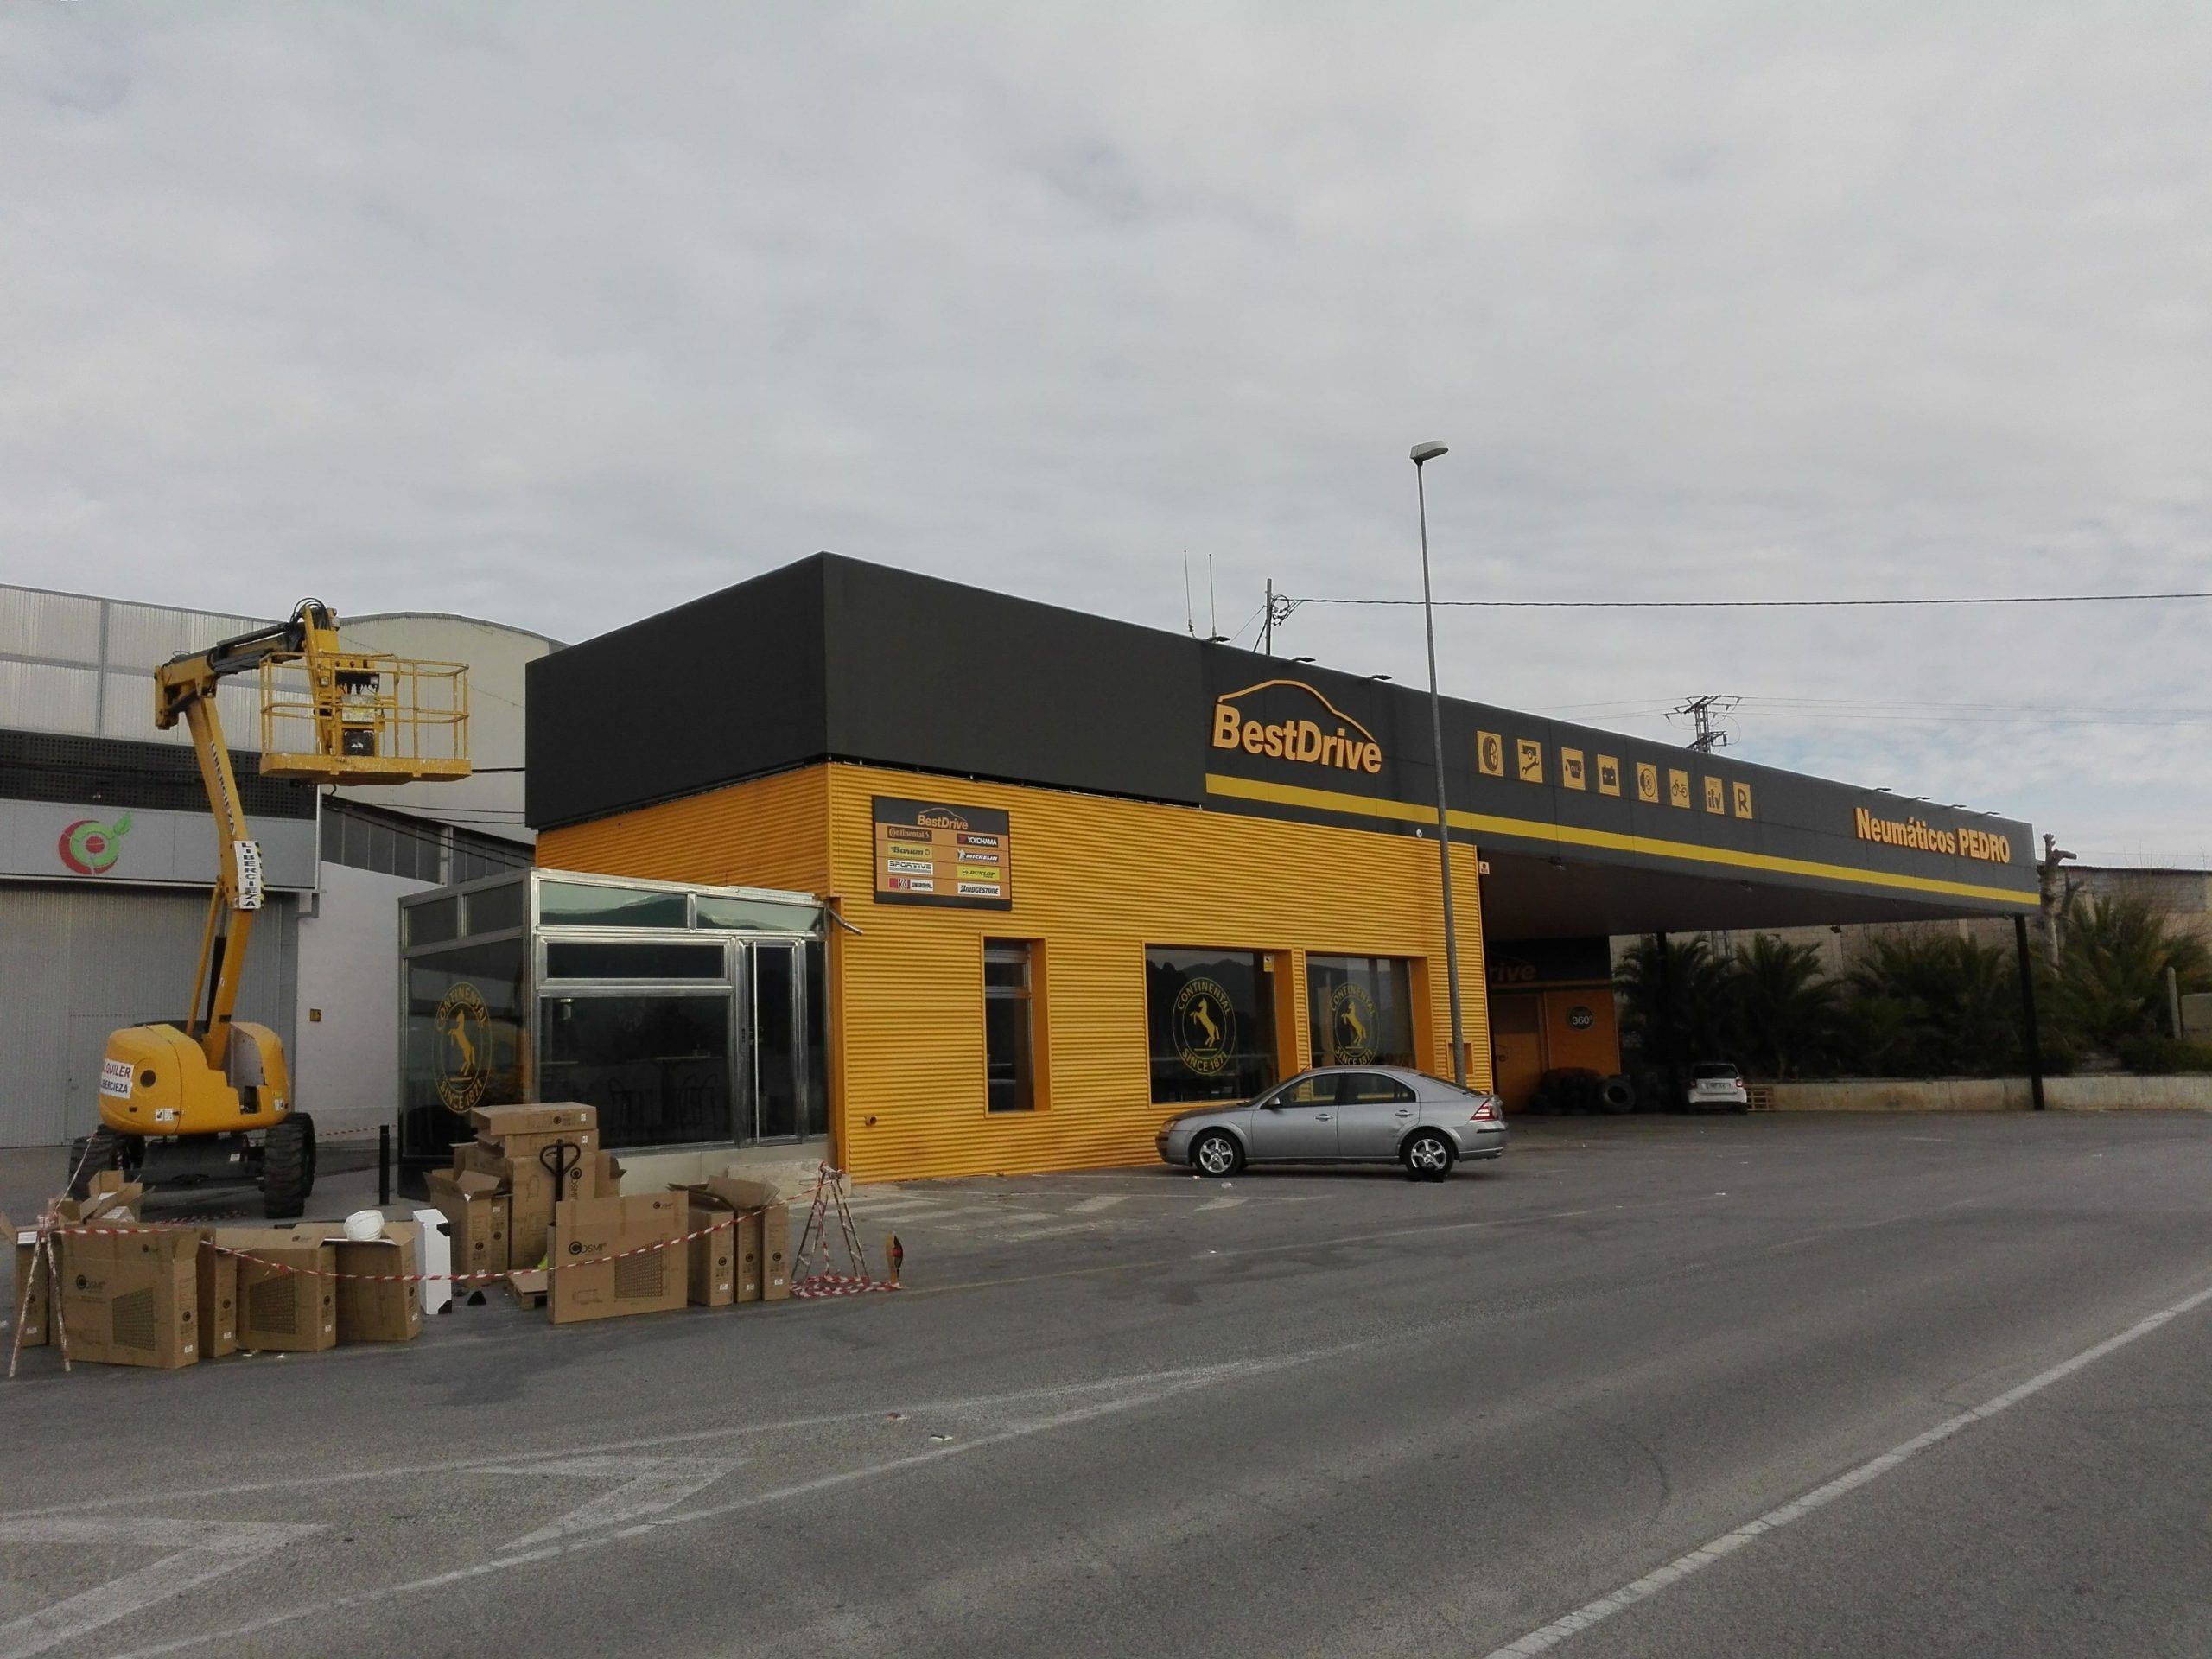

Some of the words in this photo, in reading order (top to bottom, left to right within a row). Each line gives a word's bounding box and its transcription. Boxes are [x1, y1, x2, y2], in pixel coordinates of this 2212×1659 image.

[1212, 703, 1382, 773] BestDrive
[1738, 788, 1749, 812] R
[918, 814, 969, 830] BestDrive
[967, 836, 997, 846] YOKOHAMA
[1854, 807, 1955, 855] Neumáticos
[1956, 828, 2010, 864] PEDRO
[892, 846, 924, 856] Barum
[241, 842, 257, 906] LIBERCIEZA
[960, 885, 999, 894] BRIDGESTONE
[435, 986, 487, 1031] CONTINENTAL
[1176, 981, 1232, 1017] CONTINENTAL
[1331, 984, 1376, 1017] CONTINENTAL
[1182, 1048, 1209, 1071] SINCE
[1211, 1051, 1228, 1070] 1871
[1335, 1046, 1357, 1065] SINCE
[440, 1081, 464, 1109] SINCE
